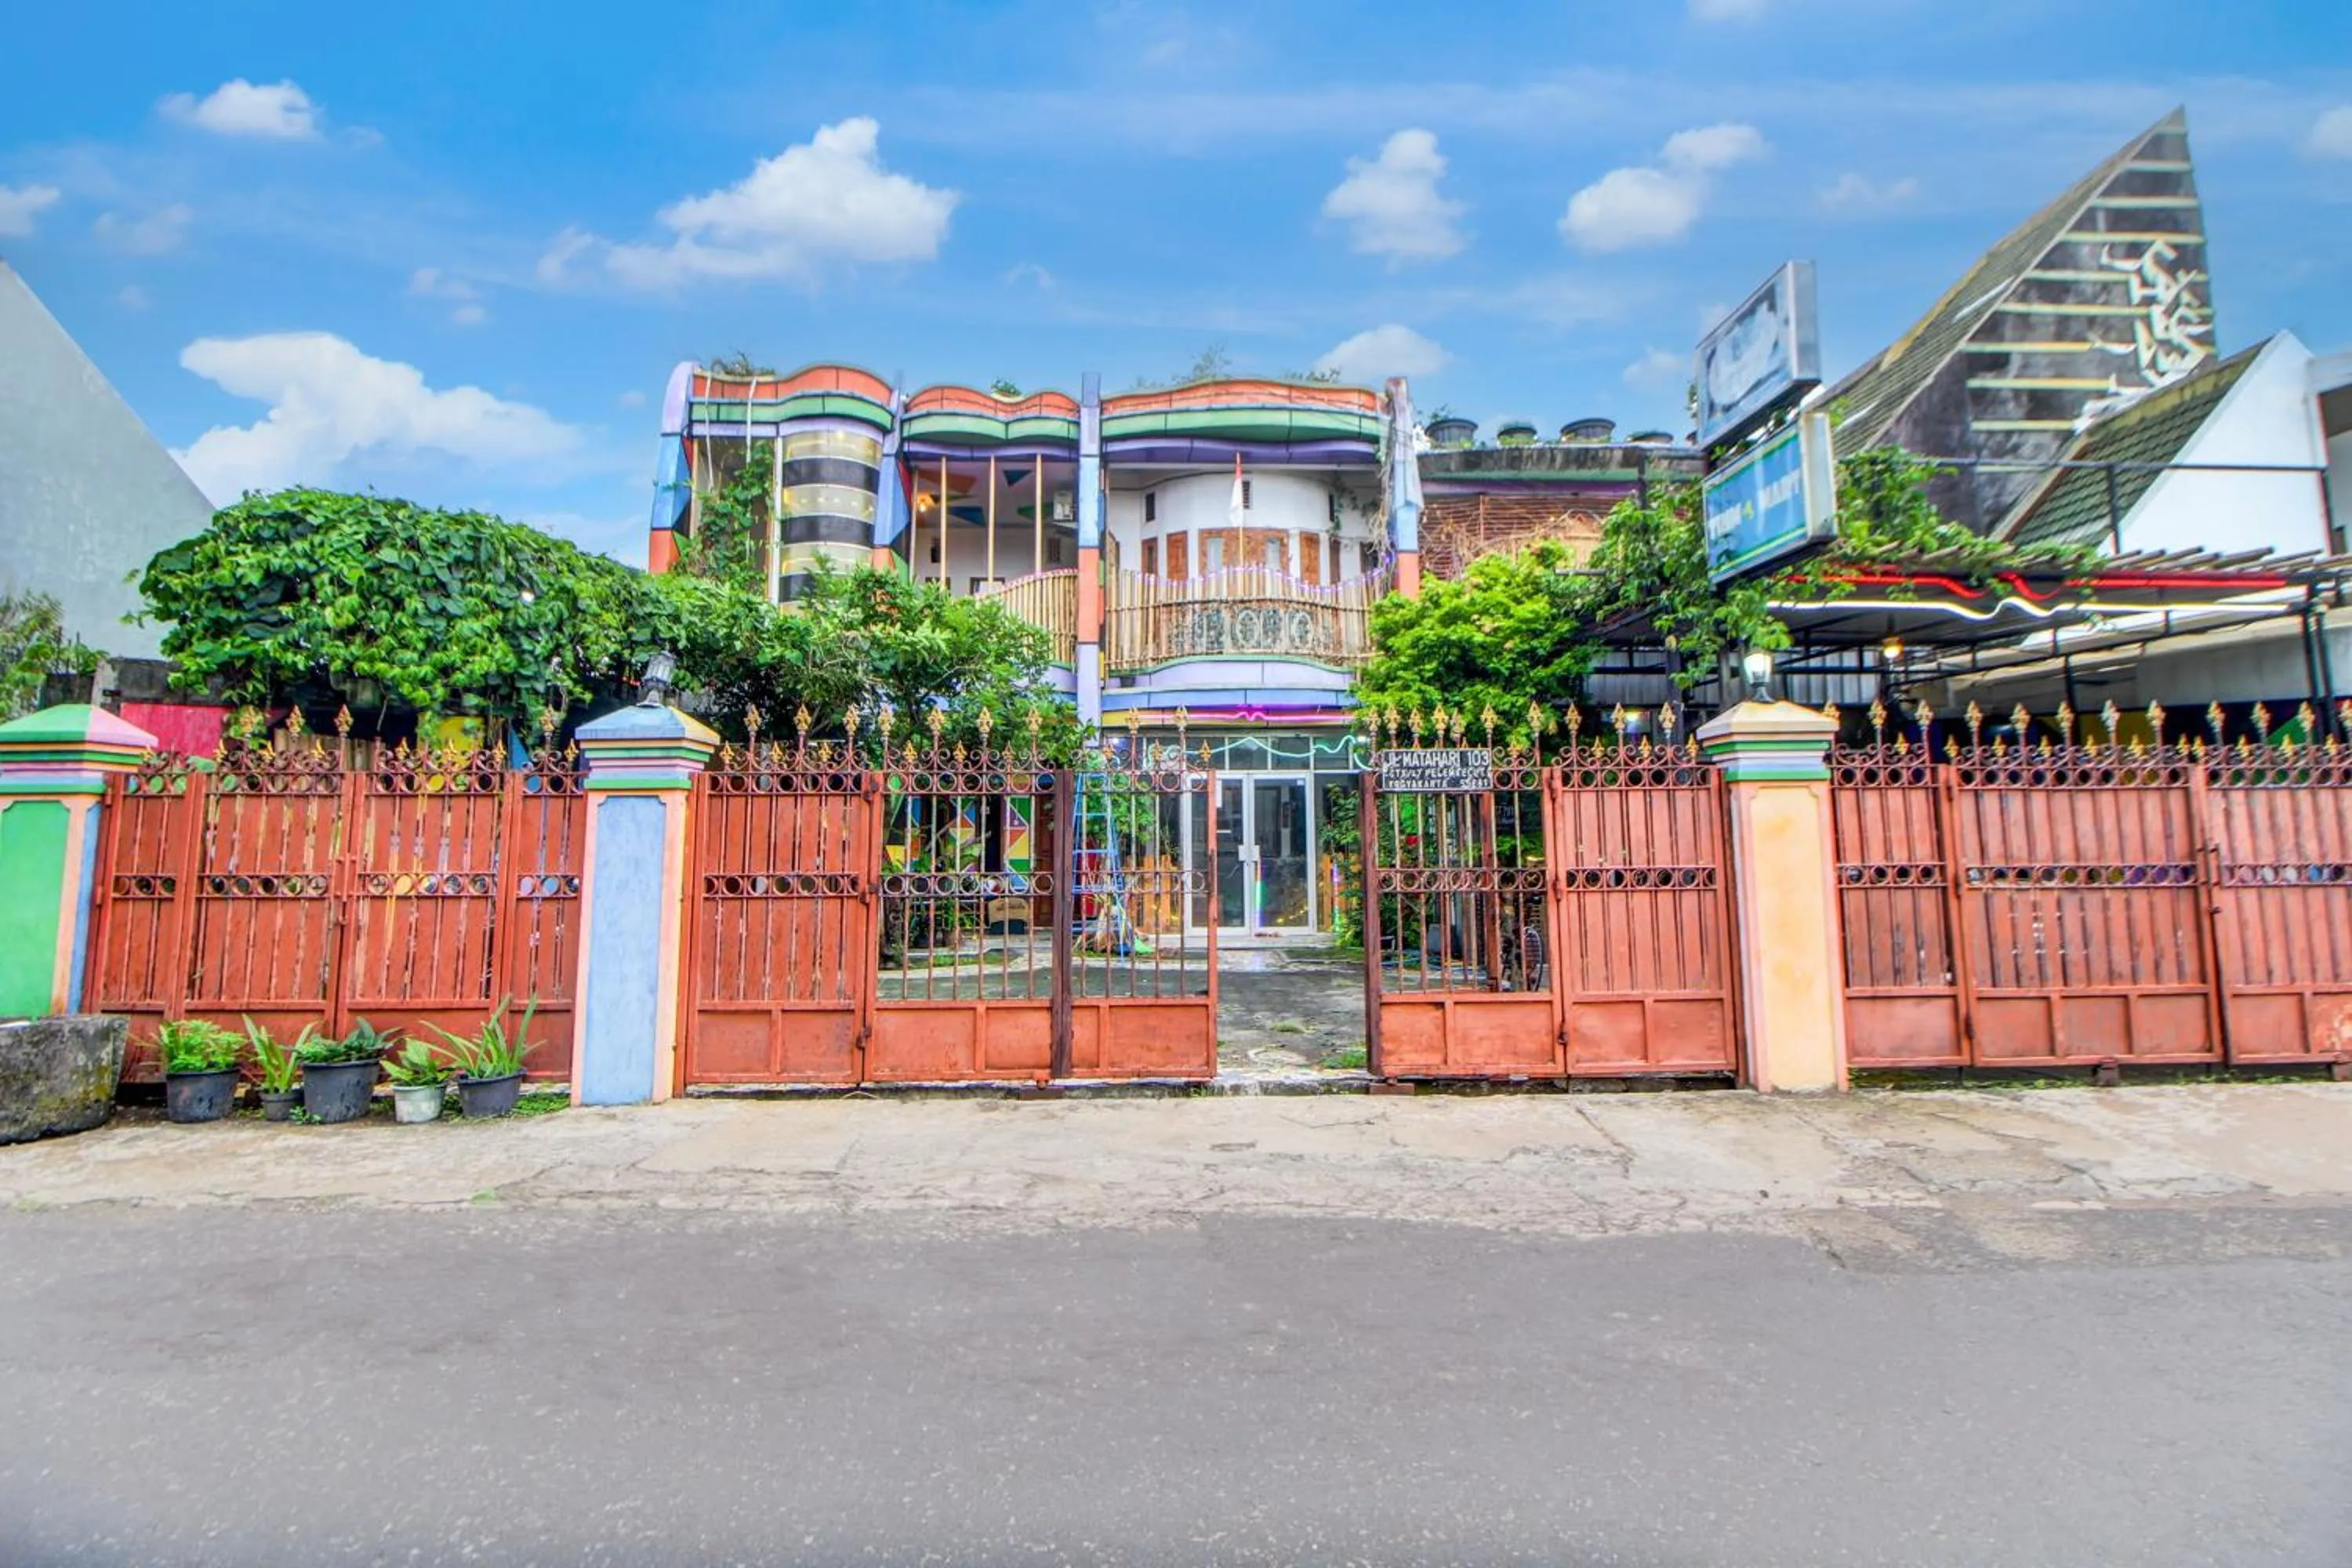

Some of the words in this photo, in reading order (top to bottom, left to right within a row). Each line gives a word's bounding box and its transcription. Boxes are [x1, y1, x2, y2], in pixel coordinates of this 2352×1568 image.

[1403, 751, 1461, 768] MATAHARI
[1468, 750, 1489, 766] 103
[1388, 779, 1448, 789] YOGYAKARTA
